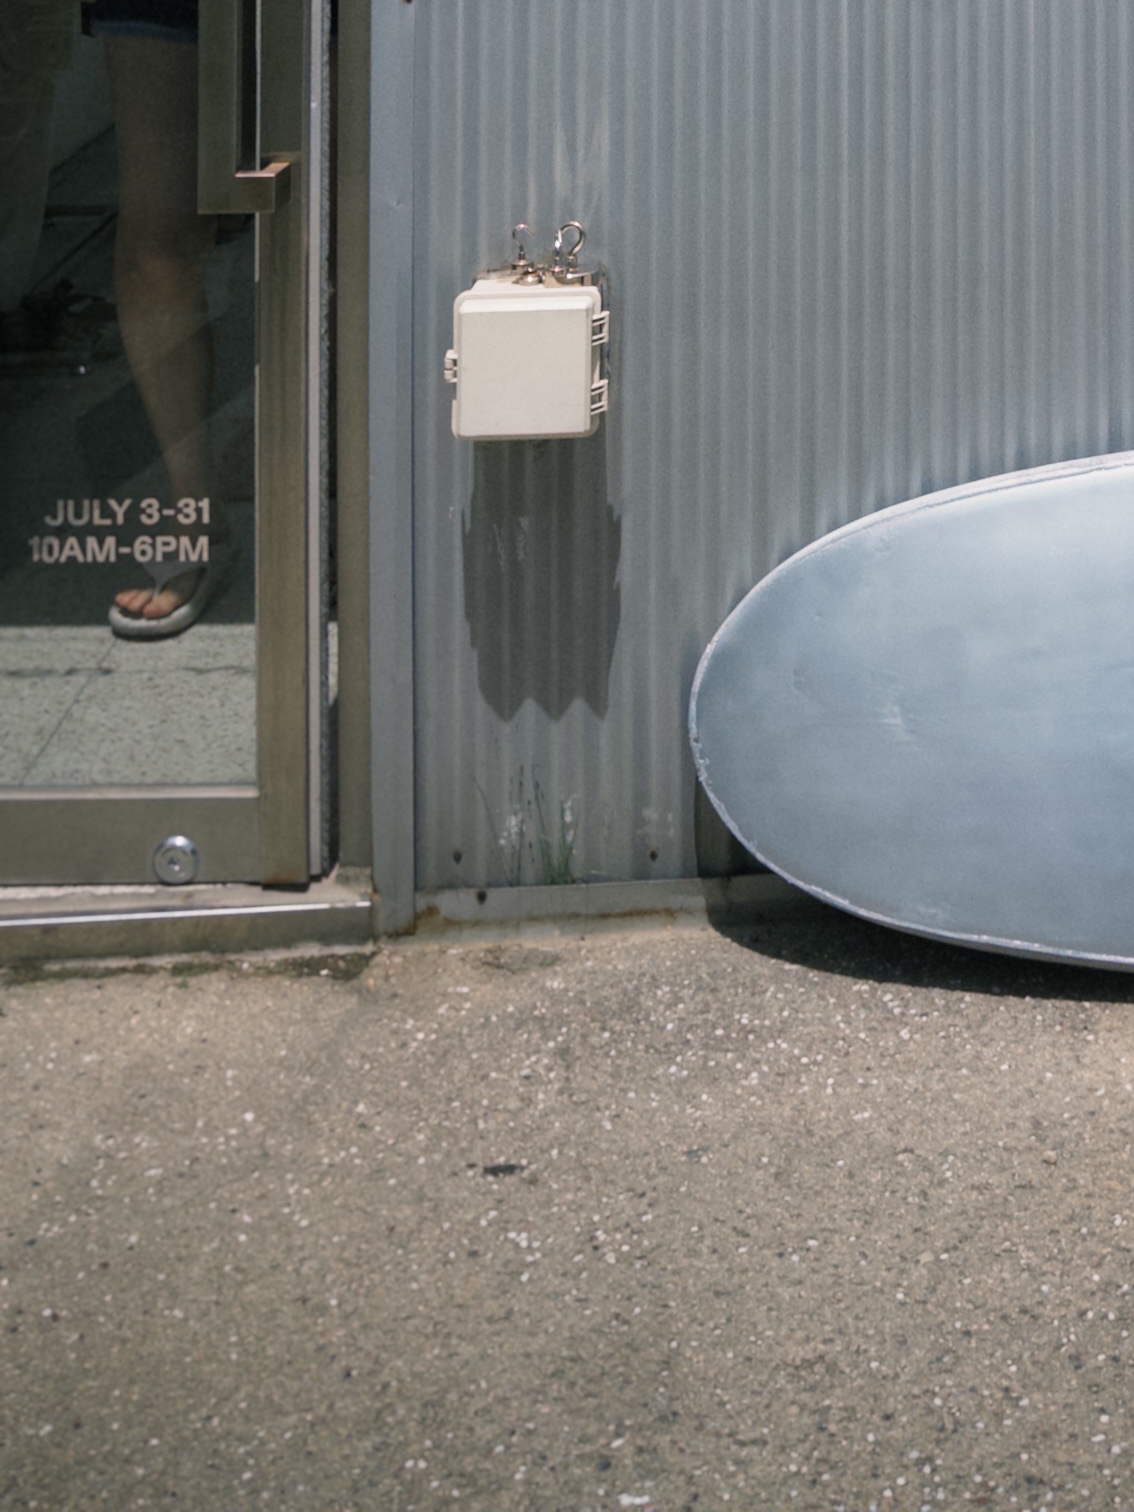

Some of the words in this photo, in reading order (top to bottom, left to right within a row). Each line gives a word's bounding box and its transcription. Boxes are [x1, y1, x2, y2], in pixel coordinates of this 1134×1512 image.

[44, 498, 132, 526] JULY
[140, 497, 211, 525] 3-31
[27, 535, 210, 564] 10AM-6PM
